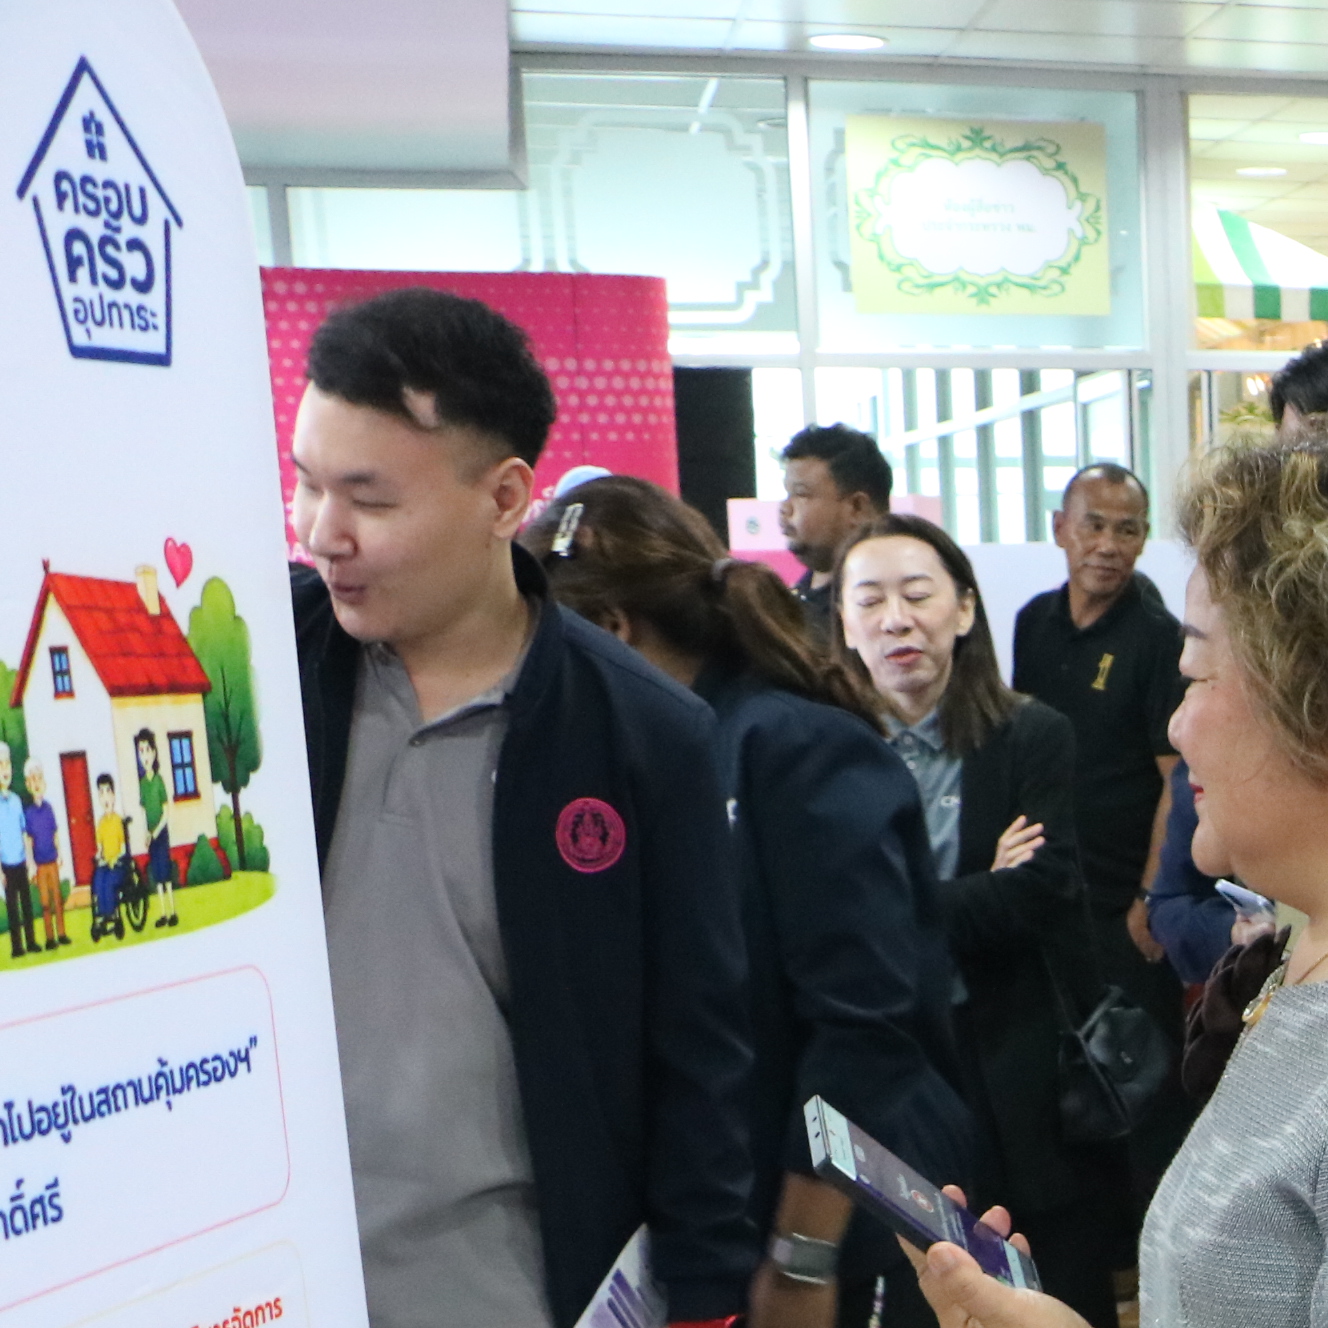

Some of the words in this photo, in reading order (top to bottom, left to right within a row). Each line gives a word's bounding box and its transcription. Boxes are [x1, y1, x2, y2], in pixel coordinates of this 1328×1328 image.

[53, 169, 149, 226] ครอบ
[63, 219, 156, 294] ครัว
[72, 292, 160, 341] อุปการะ
